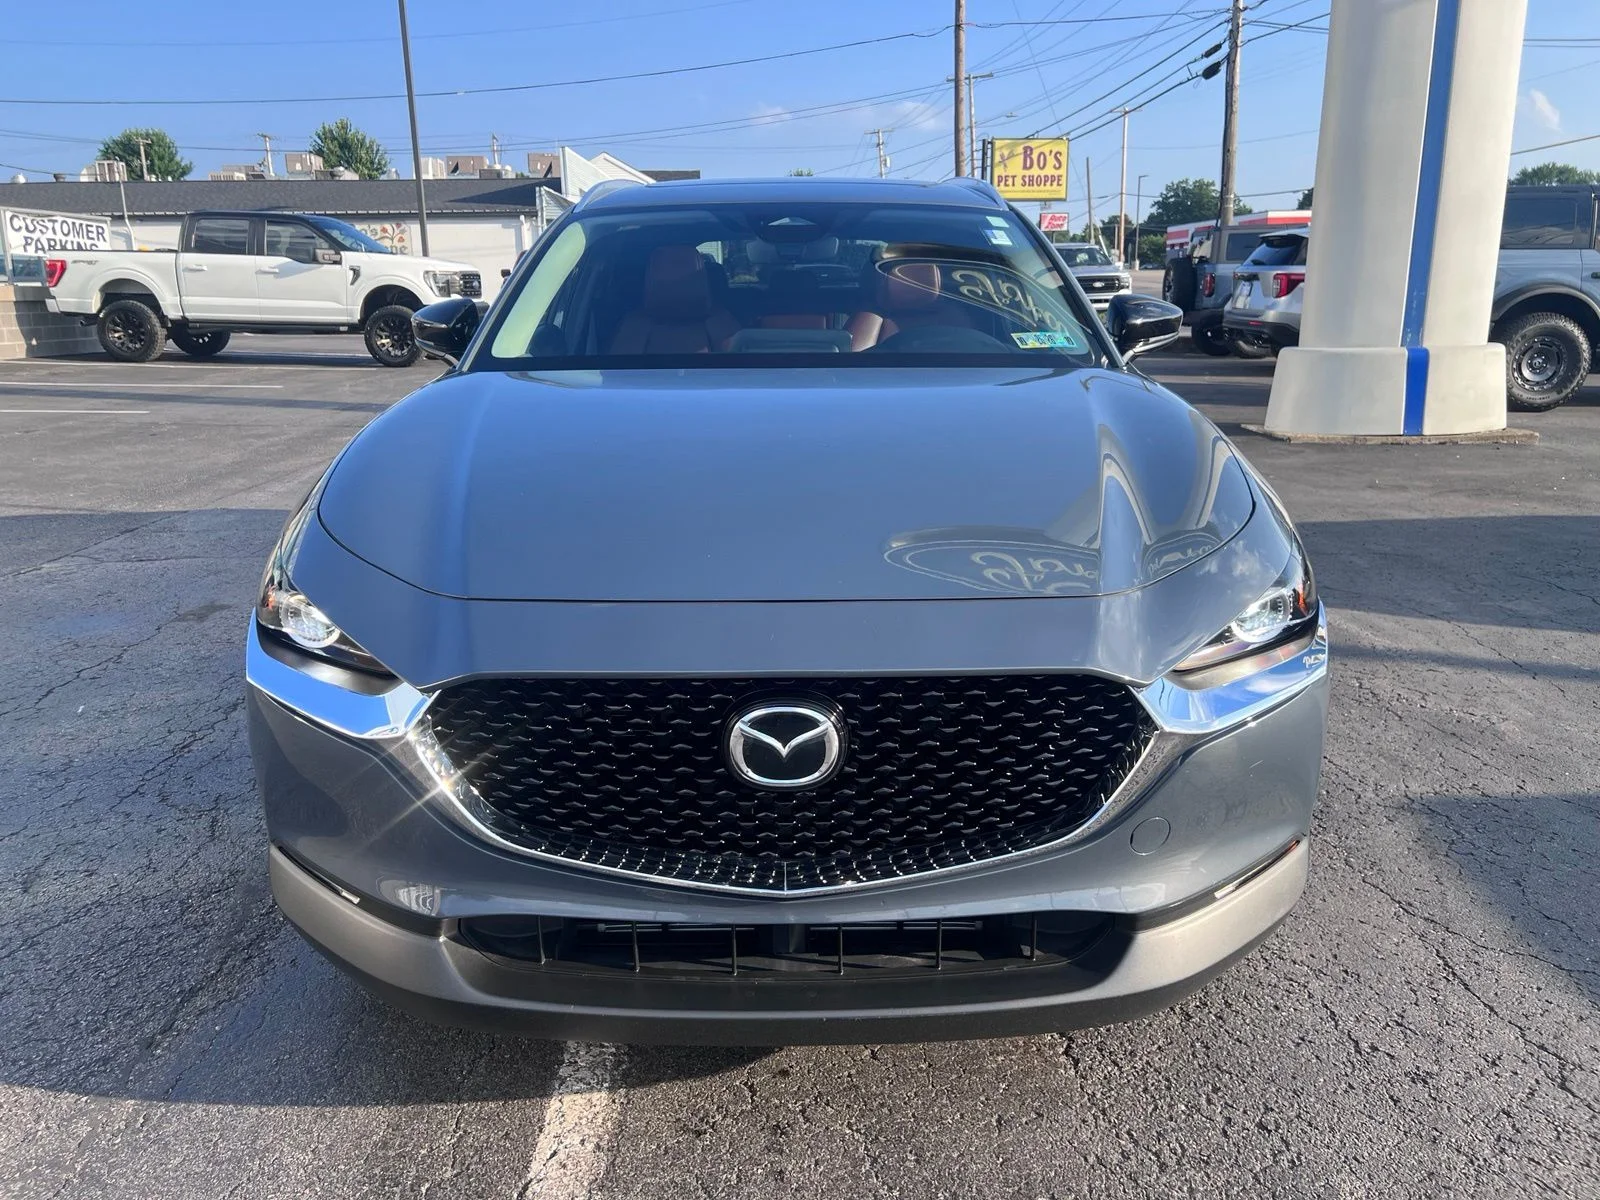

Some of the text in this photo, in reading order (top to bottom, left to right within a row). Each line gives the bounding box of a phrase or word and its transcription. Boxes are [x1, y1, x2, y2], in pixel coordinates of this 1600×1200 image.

[997, 175, 1063, 187] PET SHOPPE
[9, 214, 107, 242] CUSTOMER
